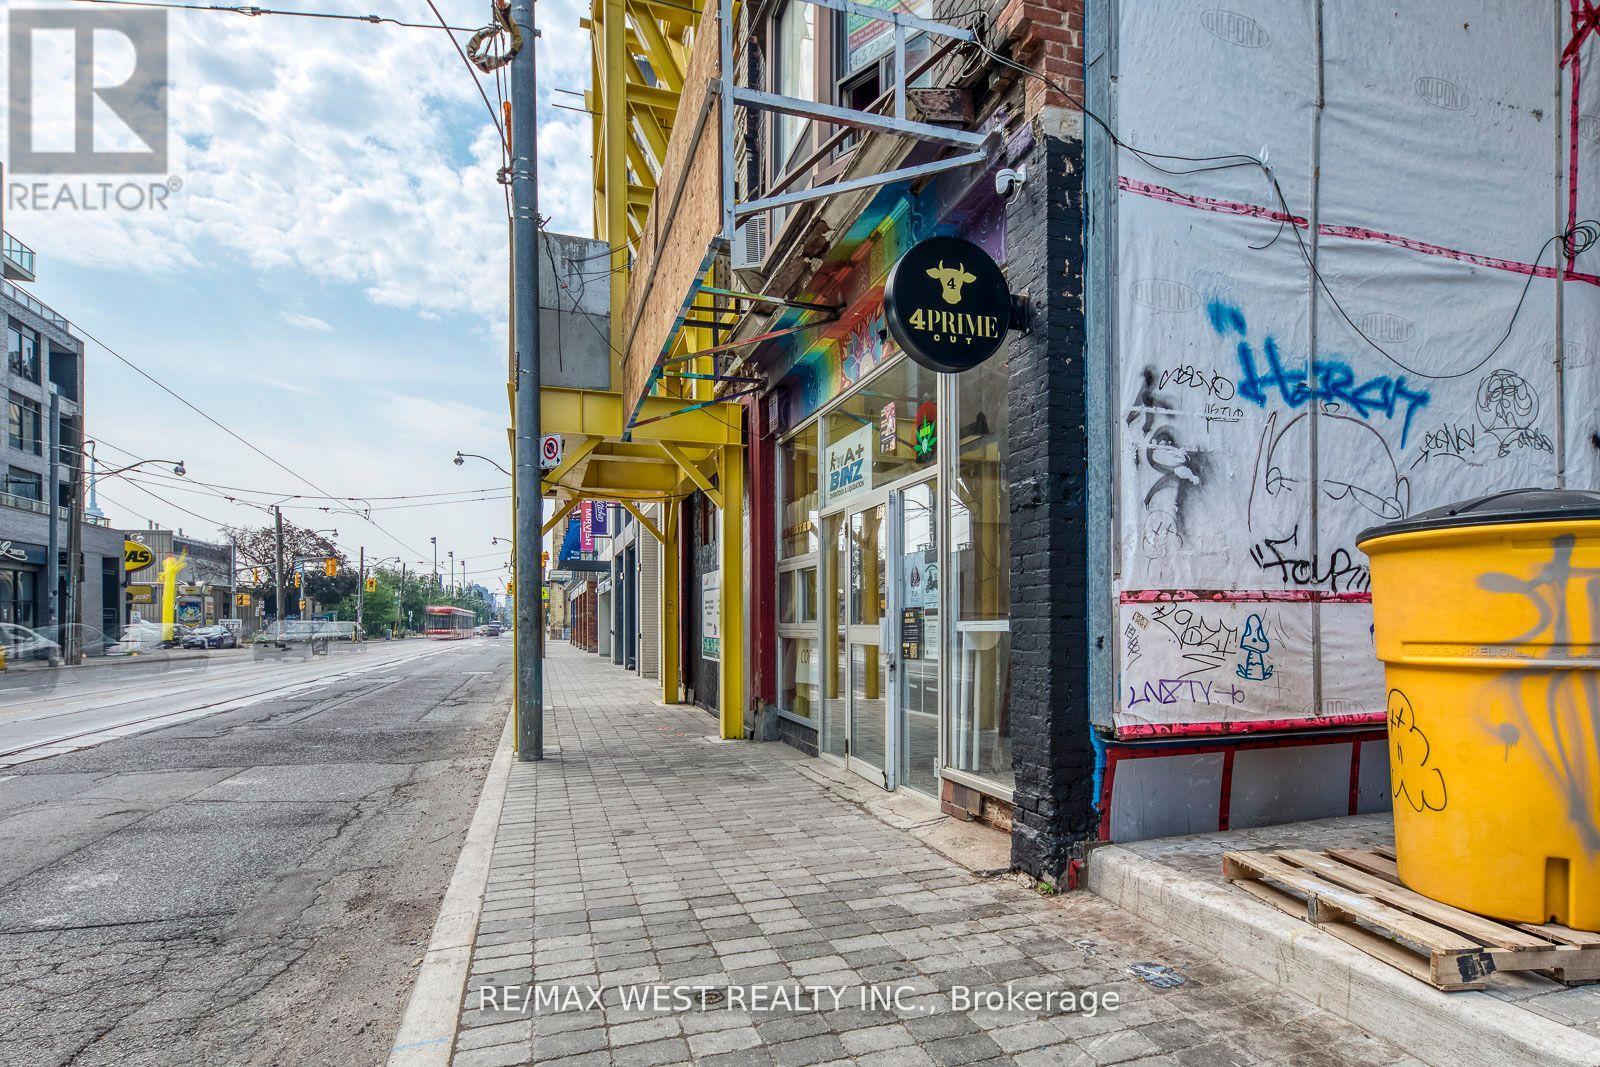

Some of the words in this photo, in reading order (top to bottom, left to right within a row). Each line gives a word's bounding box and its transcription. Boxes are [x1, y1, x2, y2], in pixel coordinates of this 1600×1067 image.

[946, 277, 957, 290] 4
[933, 334, 972, 345] CUT
[844, 443, 865, 466] A+
[830, 458, 865, 492] BINZ
[1444, 647, 1497, 658] BARREL
[1499, 648, 1538, 658] ONLY
